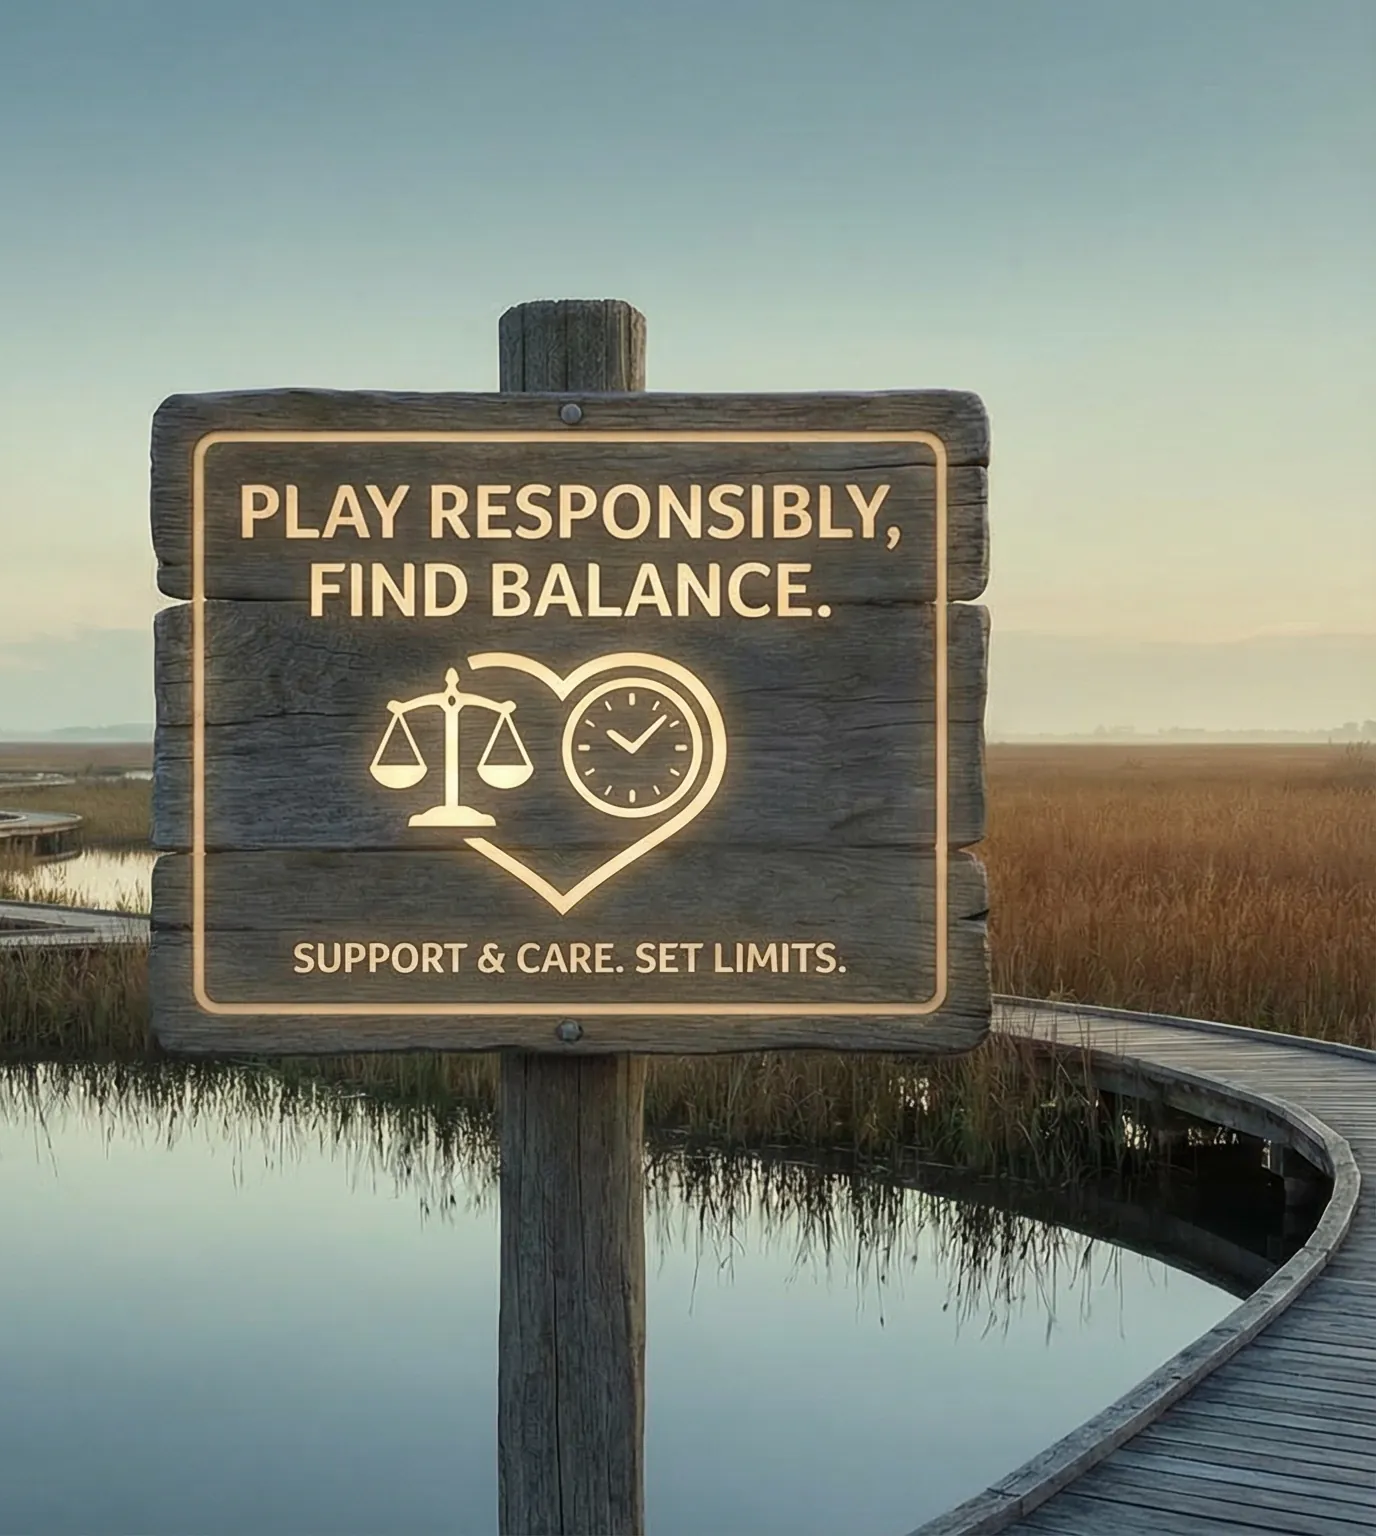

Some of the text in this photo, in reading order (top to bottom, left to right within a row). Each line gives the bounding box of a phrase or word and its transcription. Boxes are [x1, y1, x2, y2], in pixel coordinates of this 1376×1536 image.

[240, 484, 901, 550] PLAY RESPONSIBLY,
[310, 562, 832, 618] FIND BALANCE.
[293, 942, 847, 974] SUPPORT & CARE. SET LIMITS.
